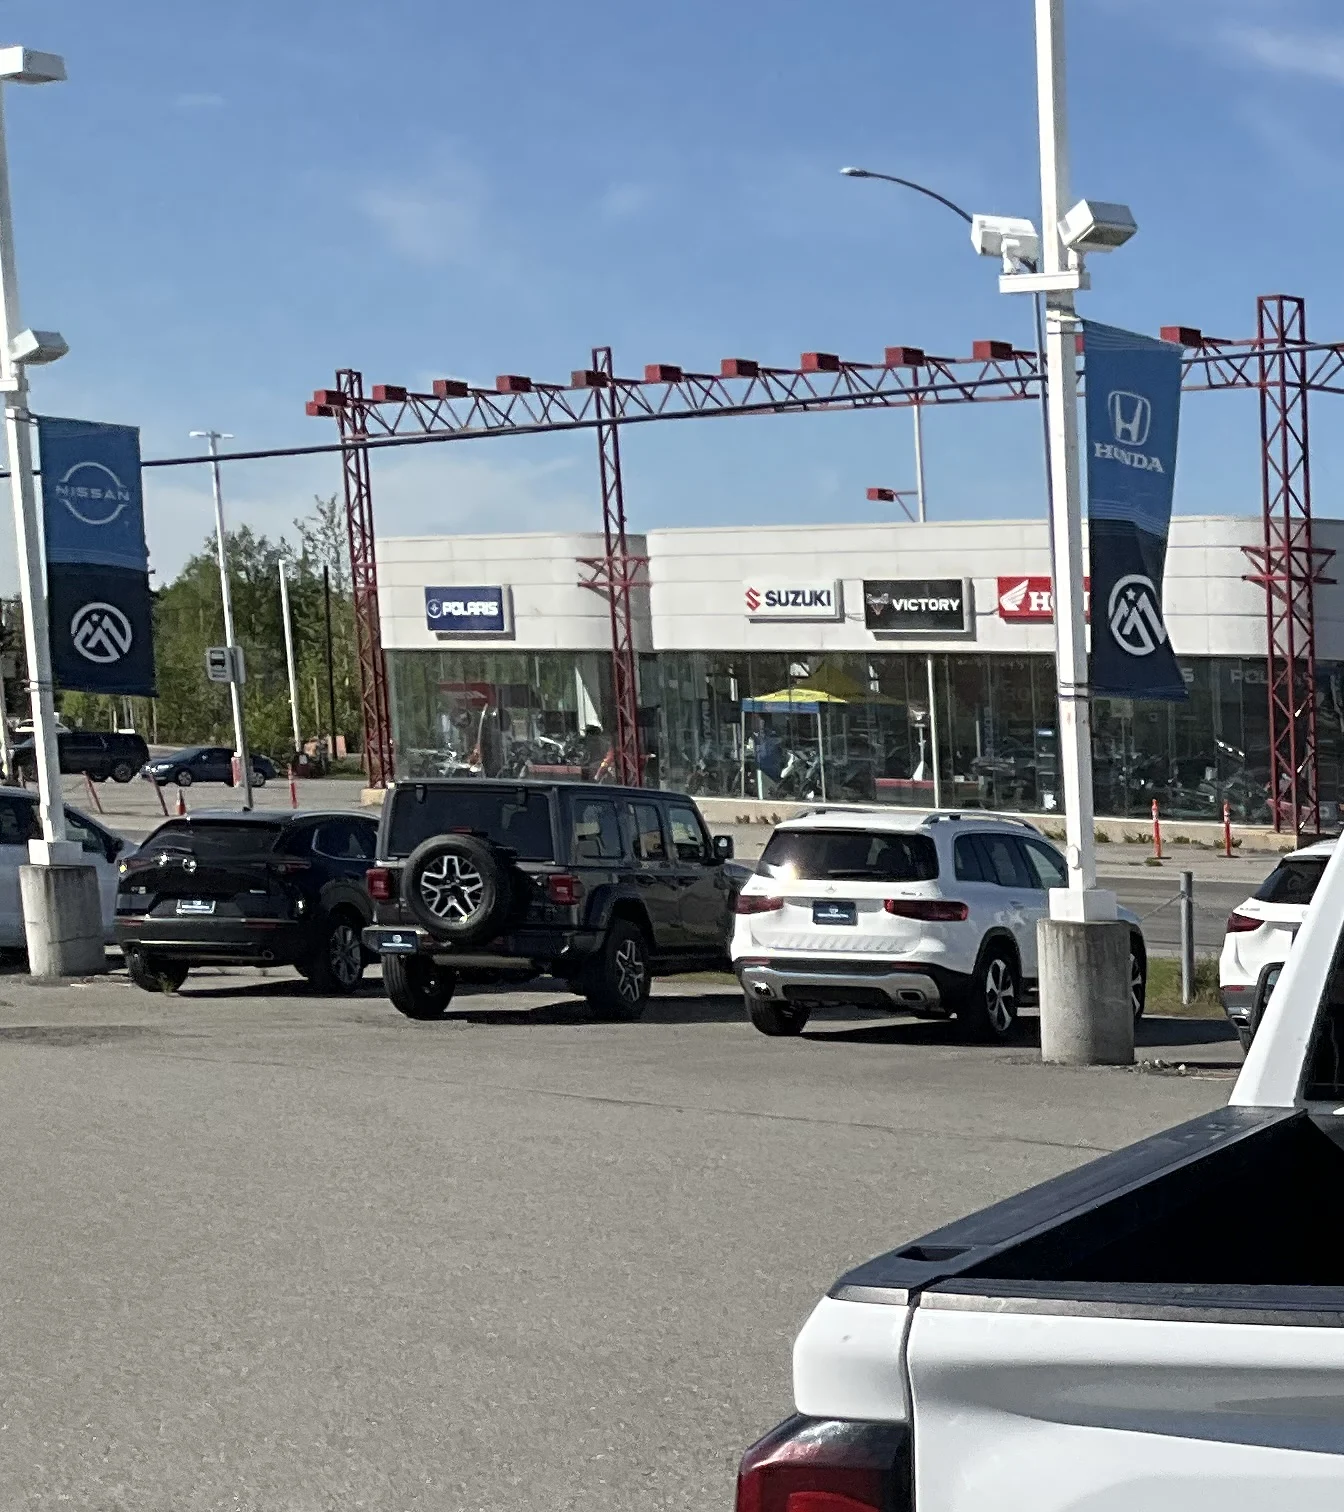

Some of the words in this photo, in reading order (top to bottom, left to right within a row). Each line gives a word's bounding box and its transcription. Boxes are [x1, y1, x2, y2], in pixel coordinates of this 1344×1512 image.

[1094, 441, 1165, 474] HONDA
[55, 485, 130, 501] NISSAN
[765, 589, 832, 607] SUZUKI
[892, 598, 960, 611] VICTORY
[442, 601, 499, 616] POLARIS
